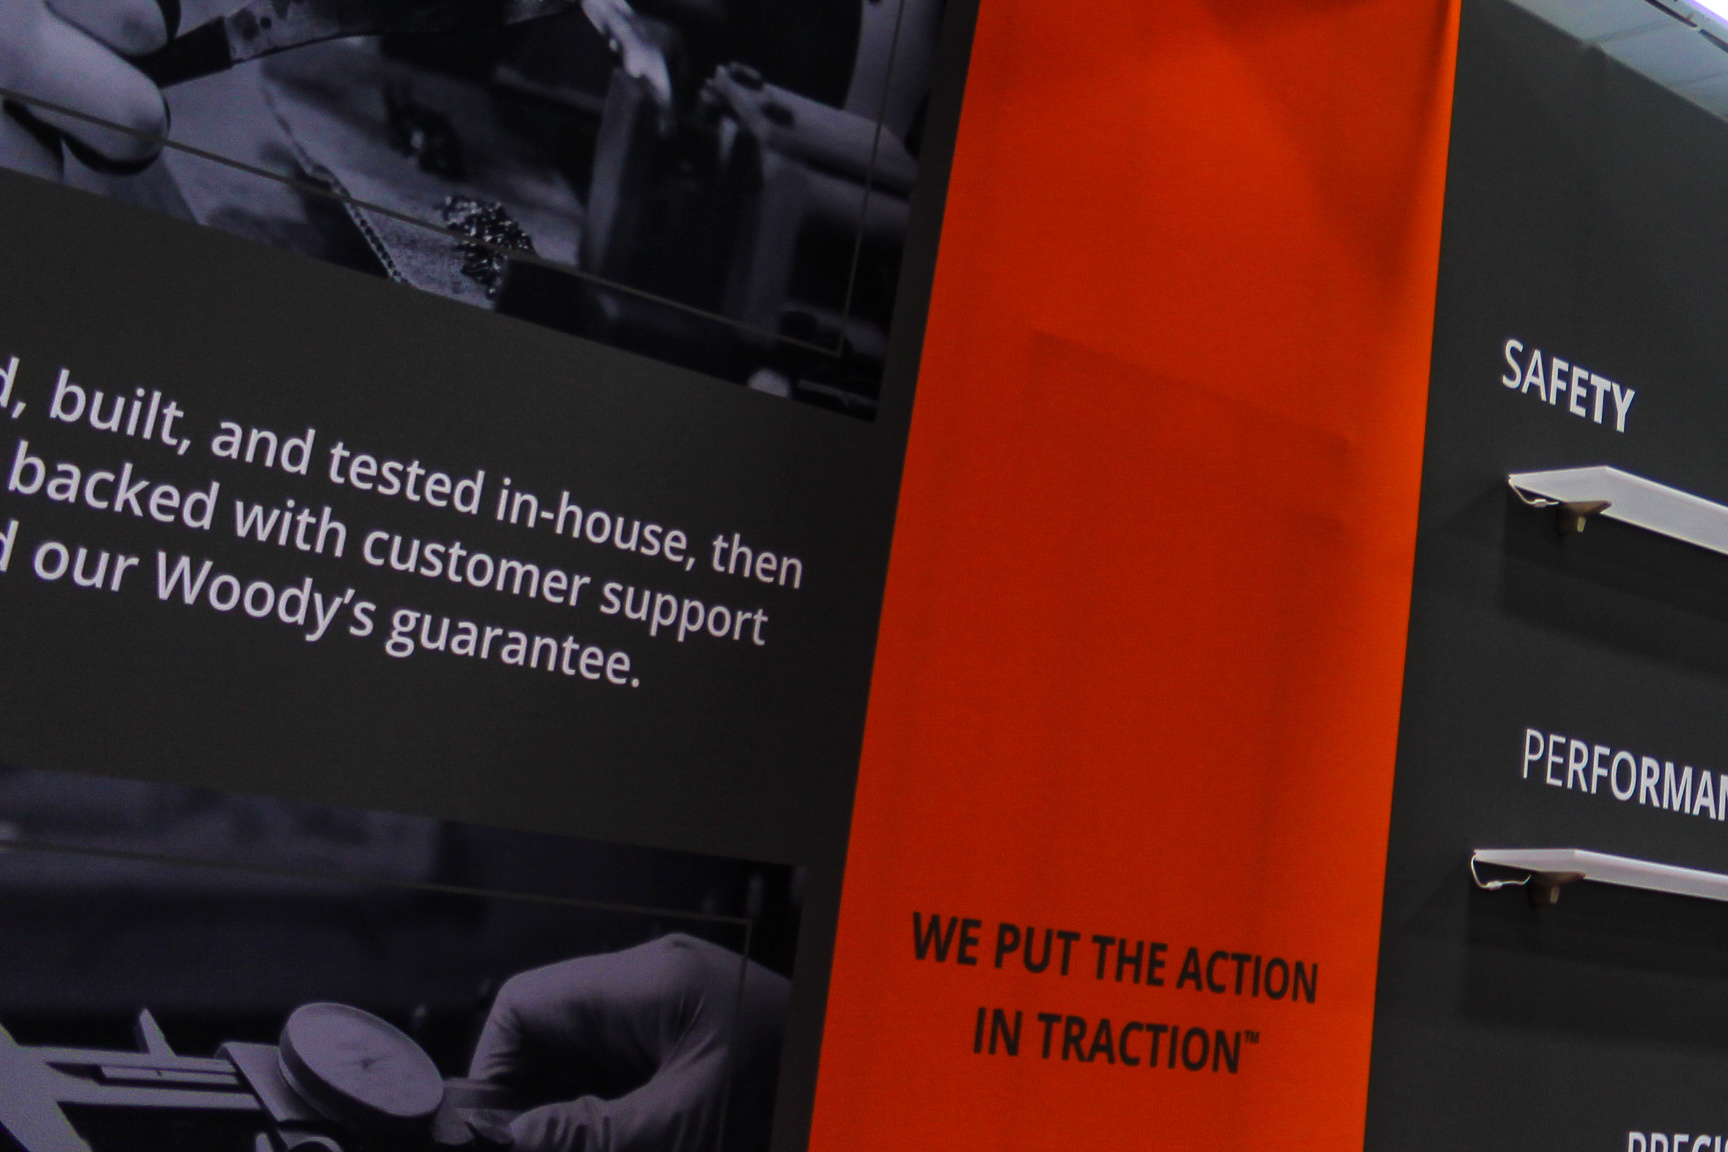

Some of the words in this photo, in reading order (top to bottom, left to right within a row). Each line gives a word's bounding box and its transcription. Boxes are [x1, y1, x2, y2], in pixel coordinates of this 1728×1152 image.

[1502, 339, 1636, 432] SAFETY
[50, 368, 191, 456] built,
[212, 422, 316, 475] and
[330, 442, 486, 514] tested
[497, 477, 696, 570] in-house,
[713, 534, 802, 589] then
[9, 439, 220, 529] backed
[236, 498, 347, 557] with
[363, 531, 592, 607] customer
[600, 582, 768, 646] support
[34, 541, 140, 591] our
[158, 551, 377, 642] Woody's
[385, 610, 640, 688] guarantee.
[913, 911, 982, 965] WE
[995, 923, 1081, 975] PUT
[1092, 934, 1168, 986] THE
[1176, 946, 1319, 1003] ACTION
[974, 1007, 1022, 1056] IN
